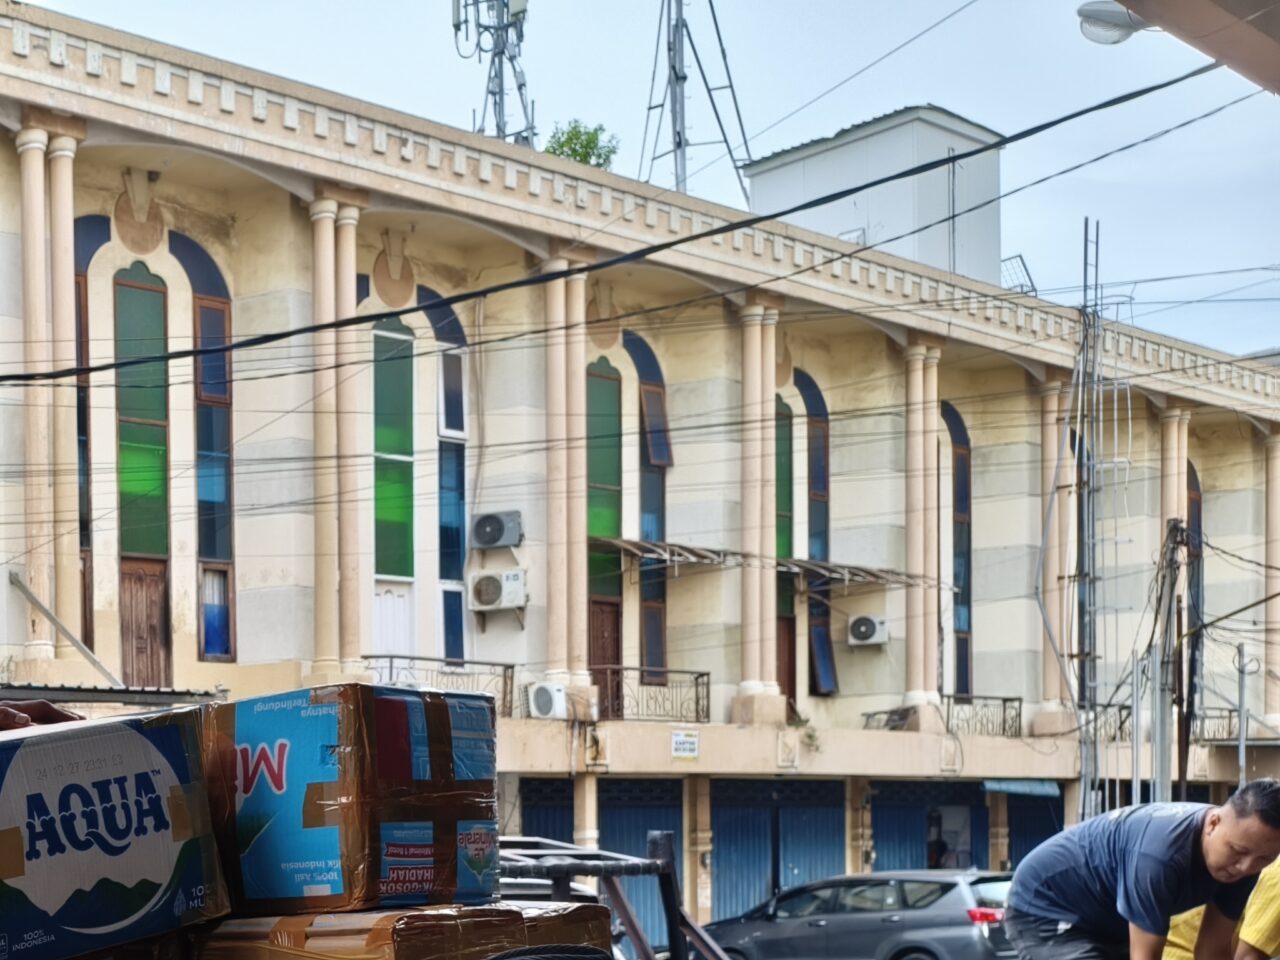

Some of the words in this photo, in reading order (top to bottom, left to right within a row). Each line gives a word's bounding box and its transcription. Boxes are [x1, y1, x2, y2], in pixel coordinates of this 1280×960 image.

[25, 771, 170, 861] AQUA
[281, 859, 327, 871] Indonesia
[389, 868, 433, 880] HADIAH
[23, 929, 44, 941] 100%
[12, 934, 55, 952] INDONESIA
